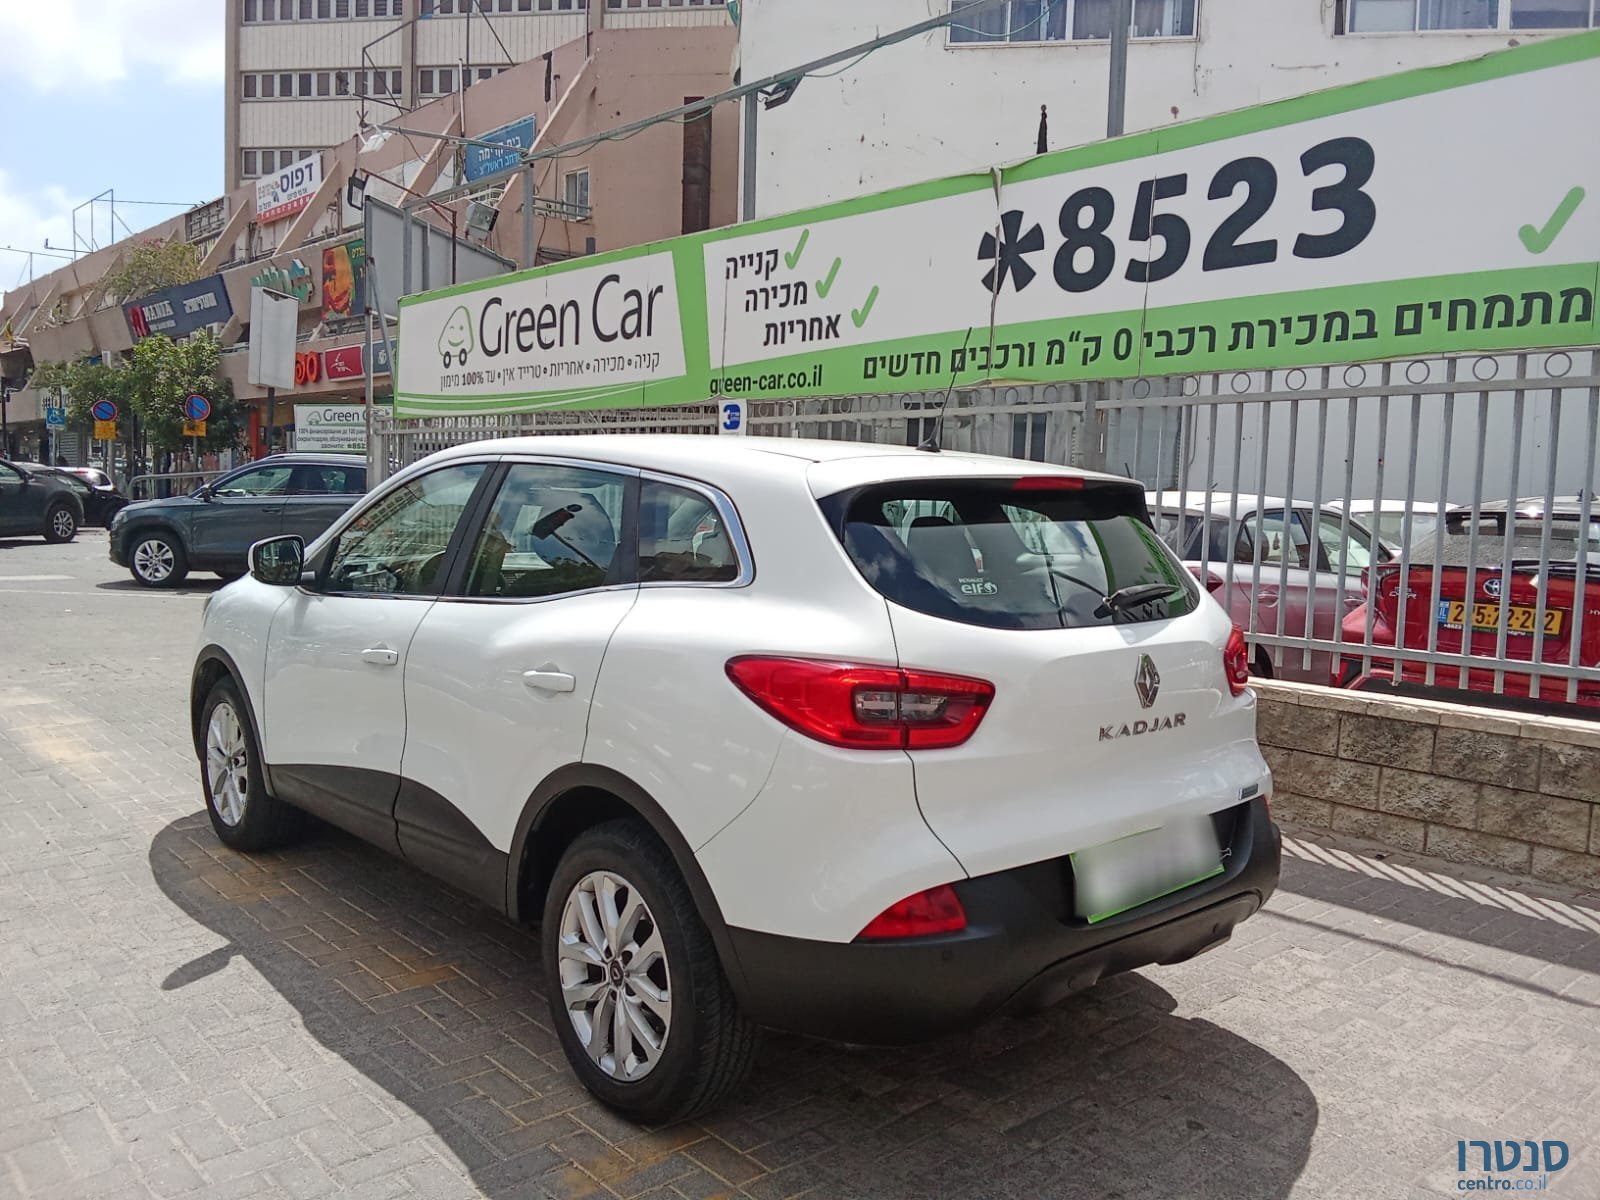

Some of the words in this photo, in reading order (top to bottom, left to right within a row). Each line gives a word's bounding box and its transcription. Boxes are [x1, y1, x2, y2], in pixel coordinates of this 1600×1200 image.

[280, 162, 314, 193] דפוס
[726, 248, 779, 280] קנייה
[745, 281, 808, 312] מכירה
[479, 296, 580, 357] Green
[592, 273, 664, 343] Car
[1394, 286, 1594, 337] מתמחים
[763, 313, 842, 346] אחריות
[1143, 325, 1216, 358] רכבי
[1227, 308, 1378, 352] במכירת
[549, 360, 584, 377] אחריות
[593, 357, 625, 373] מכירה
[634, 352, 661, 372] קניה
[863, 350, 942, 380] חדשים
[951, 340, 1035, 374] ורכבים
[440, 374, 460, 392] מימון
[462, 371, 484, 386] 100%
[484, 370, 496, 384] עד
[502, 367, 515, 386] אין
[517, 364, 542, 380] טרייד
[710, 364, 823, 397] green-car.co.il
[323, 408, 360, 422] Green
[961, 583, 983, 594] elf
[1439, 607, 1447, 618] IL
[1099, 712, 1187, 741] KADJAR
